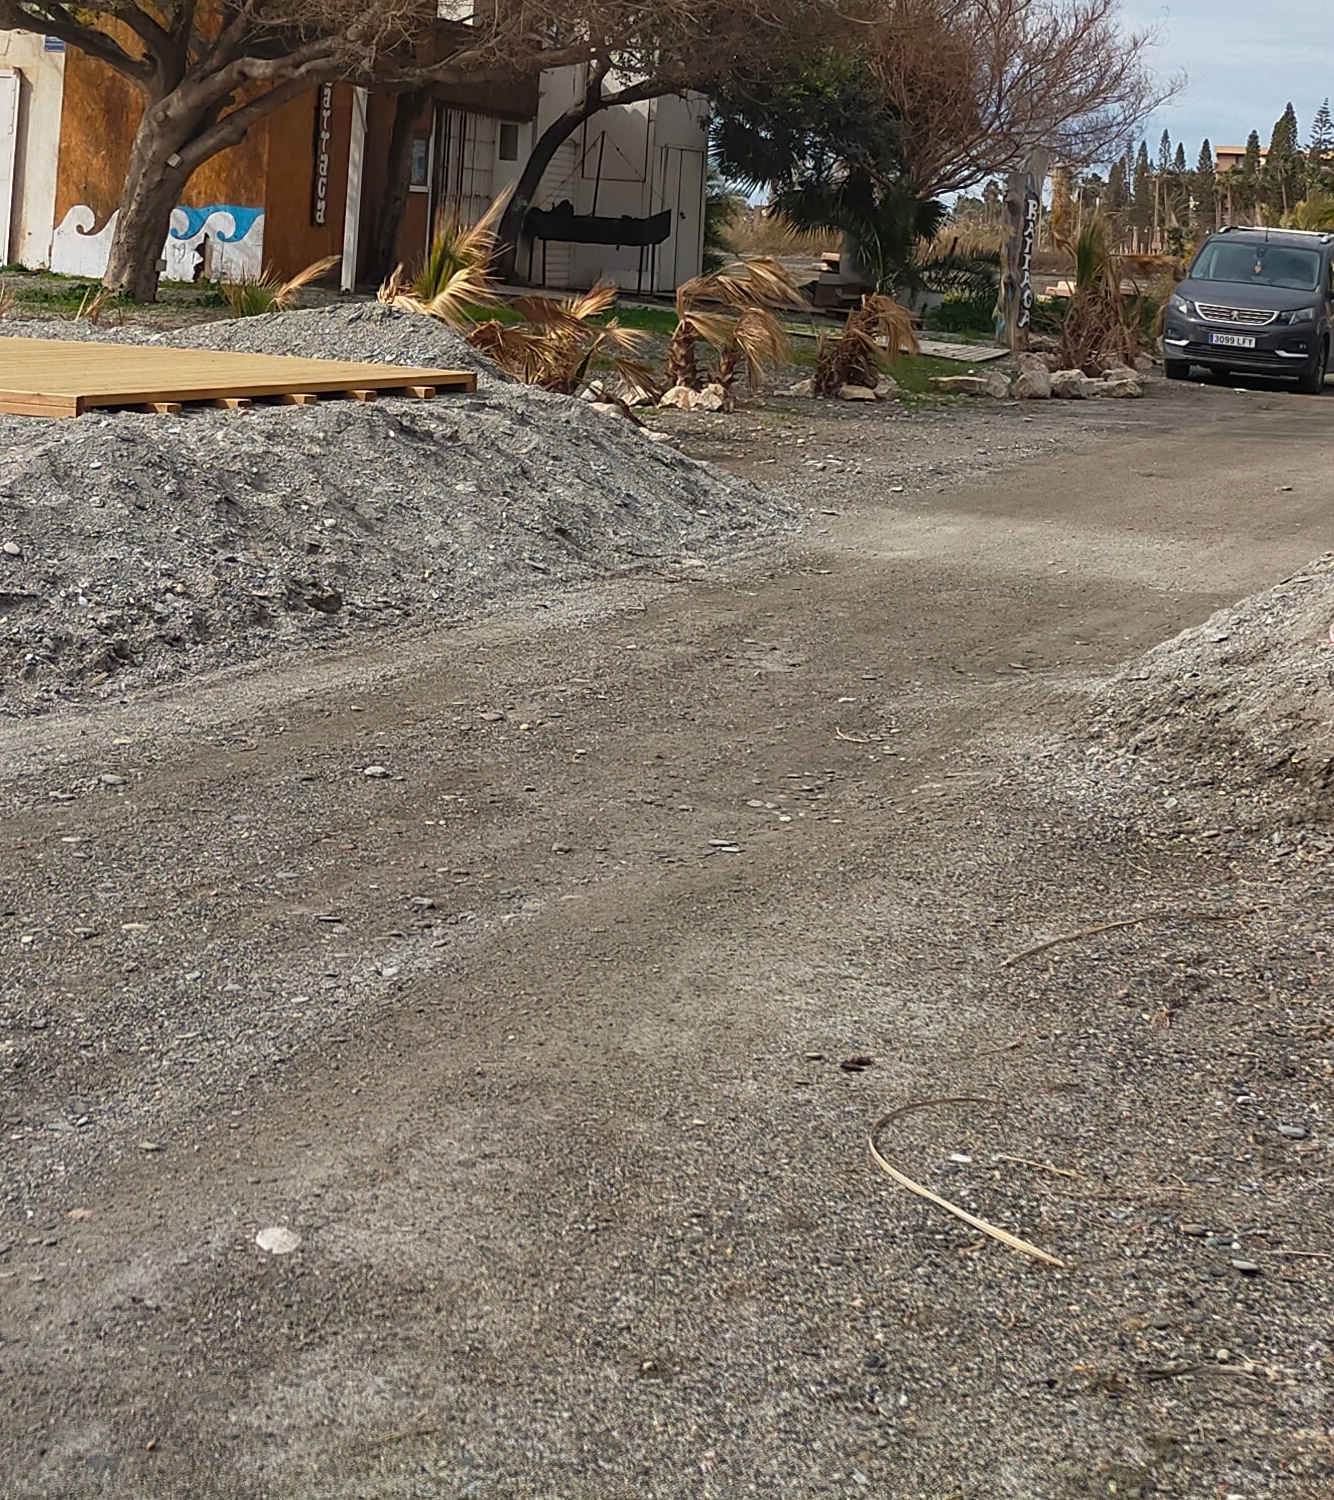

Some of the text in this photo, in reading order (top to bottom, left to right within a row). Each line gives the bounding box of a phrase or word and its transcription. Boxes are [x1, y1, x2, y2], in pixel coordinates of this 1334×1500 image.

[316, 82, 333, 224] arraca
[1214, 334, 1254, 347] 3099 LFY
